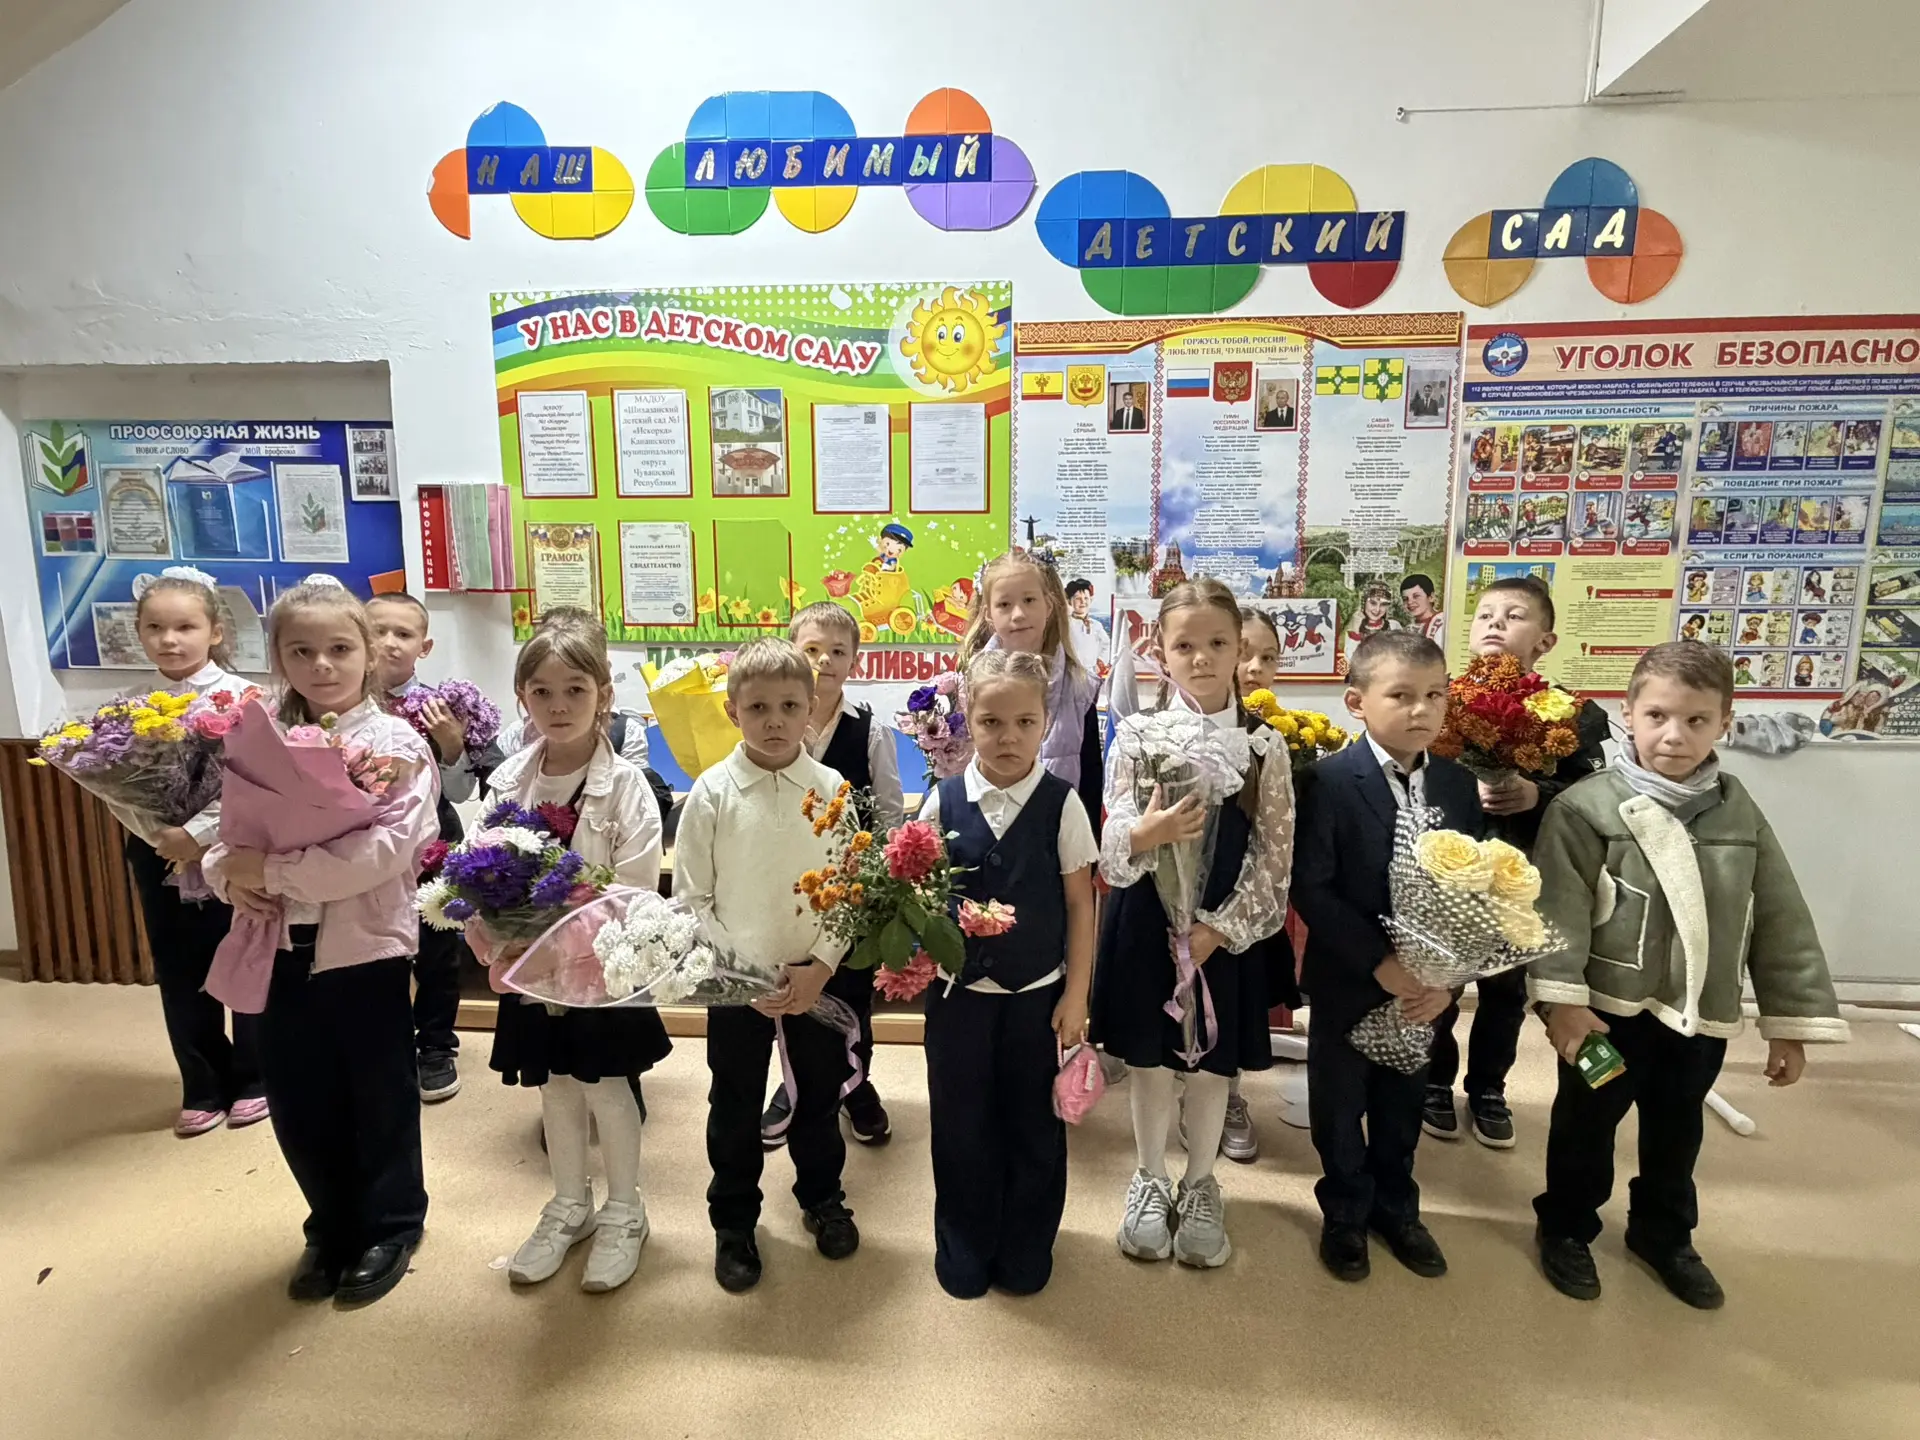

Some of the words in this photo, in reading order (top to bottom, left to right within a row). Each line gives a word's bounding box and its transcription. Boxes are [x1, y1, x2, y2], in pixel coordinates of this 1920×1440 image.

[477, 153, 585, 186] НАШ
[695, 136, 978, 182] ЛЮБИМЫЙ
[1084, 211, 1393, 261] ДЕТСКИЙ
[1500, 209, 1626, 251] САД
[519, 319, 541, 346] У
[550, 310, 610, 340] НАС
[618, 309, 637, 334] В
[644, 310, 789, 357] ДЕТСКОМ
[795, 338, 880, 372] САДУ
[1183, 337, 1220, 345] ГОРЖУСЬ
[1222, 335, 1251, 345] ТОБОЙ,
[1252, 335, 1287, 343] РОССИЯ!
[1202, 347, 1223, 355] ТЕБЯ,
[1225, 345, 1278, 354] ЧУВАШСКИЙ
[1280, 344, 1302, 353] КРАЙ!
[1556, 342, 1695, 370] УГОЛОК
[1717, 338, 1920, 366] БЕЗОПАСНО
[634, 395, 666, 404] МАДОУ
[1498, 408, 1541, 416] ПРАВИЛА
[1585, 406, 1661, 415] БЕЗОПАСНОСТИ
[1748, 404, 1796, 412] ПРИЧИНЫ
[1798, 403, 1839, 411] ПОЖАРА
[622, 416, 652, 424] детский
[668, 415, 680, 424] №1
[110, 424, 249, 440] ПРОФСОЮЗНАЯ
[253, 425, 321, 440] ЖИЗНЬ
[164, 446, 189, 455] СЛОВО
[245, 446, 261, 455] МОЙ
[641, 459, 666, 467] округа
[1723, 479, 1779, 488] ПОВЕДЕНИЕ
[1782, 479, 1801, 487] ПРИ
[1803, 478, 1843, 487] ПОЖАРЕ
[421, 491, 434, 585] ИНФОРМАЦИЯ
[541, 553, 584, 562] ГРАМОТА
[1723, 552, 1748, 560] ЕСЛИ
[1751, 552, 1766, 560] ТЫ
[1768, 552, 1824, 560] ПОРАНИЛСЯ
